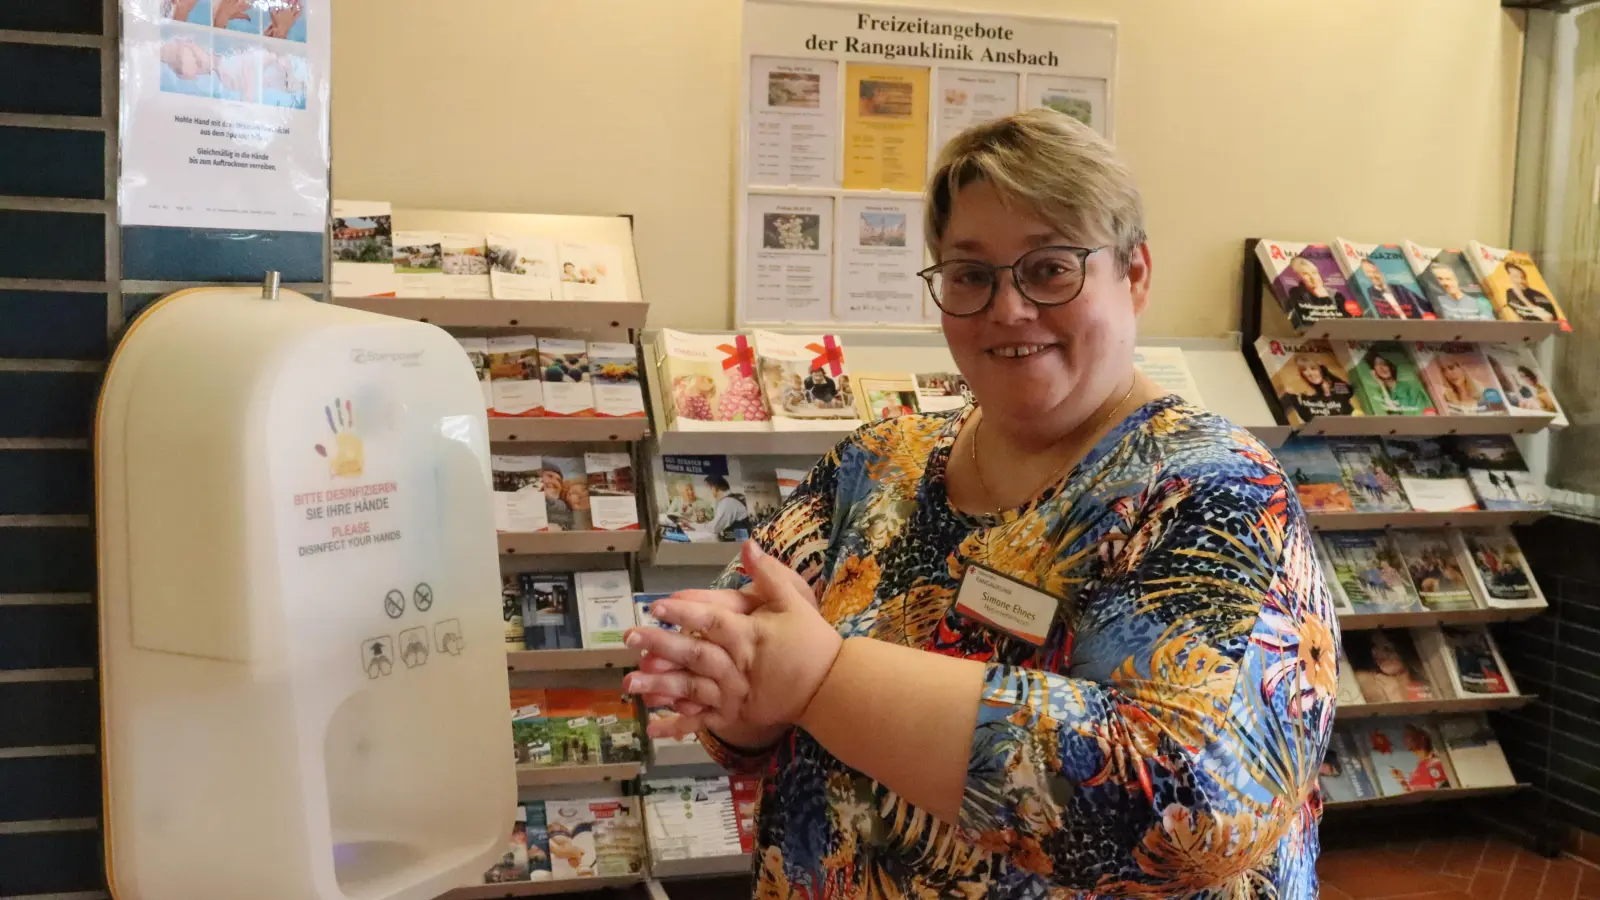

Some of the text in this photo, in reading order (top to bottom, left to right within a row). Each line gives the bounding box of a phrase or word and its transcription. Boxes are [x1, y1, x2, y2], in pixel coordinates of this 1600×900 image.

[856, 13, 1014, 42] Freizeitangebote
[805, 34, 1060, 67] der Rangauklinik Ansbach
[174, 115, 193, 124] Hohle
[194, 117, 210, 126] Hand
[211, 119, 221, 127] mit
[212, 129, 225, 137] dem
[197, 147, 233, 159] Gleichmäßig
[241, 151, 250, 159] die
[251, 152, 269, 161] Hände
[213, 159, 248, 168] Auftrocknen
[293, 482, 397, 506] BITTE DESINFIZIEREN
[306, 497, 390, 520] SIE IHRE HÄNDE
[331, 521, 370, 538] PLEASE
[298, 530, 402, 556] DISINFECT YOUR HANDS
[982, 592, 1011, 611] Simone
[1012, 604, 1036, 621] Ehnes
